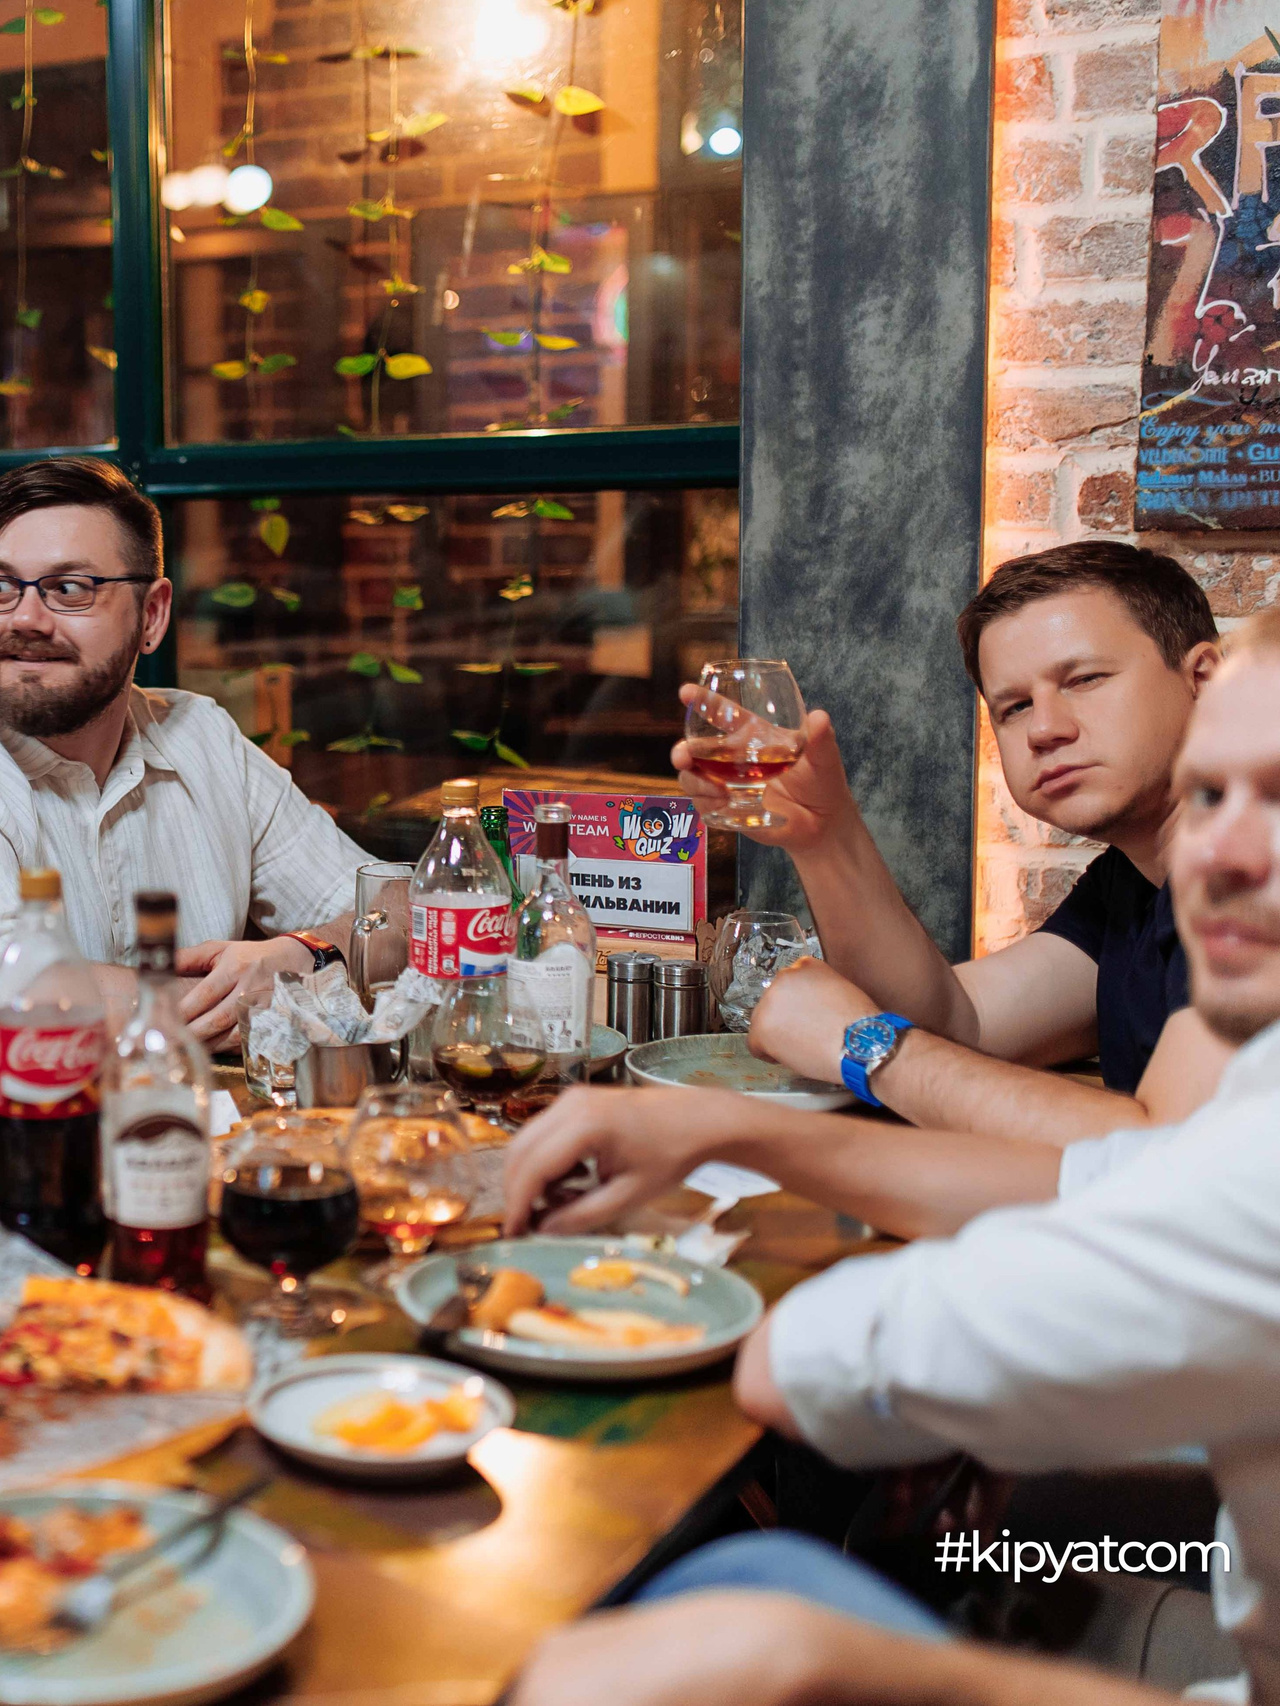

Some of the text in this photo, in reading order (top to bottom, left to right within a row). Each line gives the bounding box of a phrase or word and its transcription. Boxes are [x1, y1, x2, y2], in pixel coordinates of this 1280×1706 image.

[1140, 415, 1200, 447] Enjoy
[1201, 423, 1251, 445] your
[568, 824, 610, 837] TEAM
[635, 836, 674, 857] QUIZ
[618, 876, 642, 891] ИЗ
[575, 894, 681, 915] ИЛЬВАНИИ
